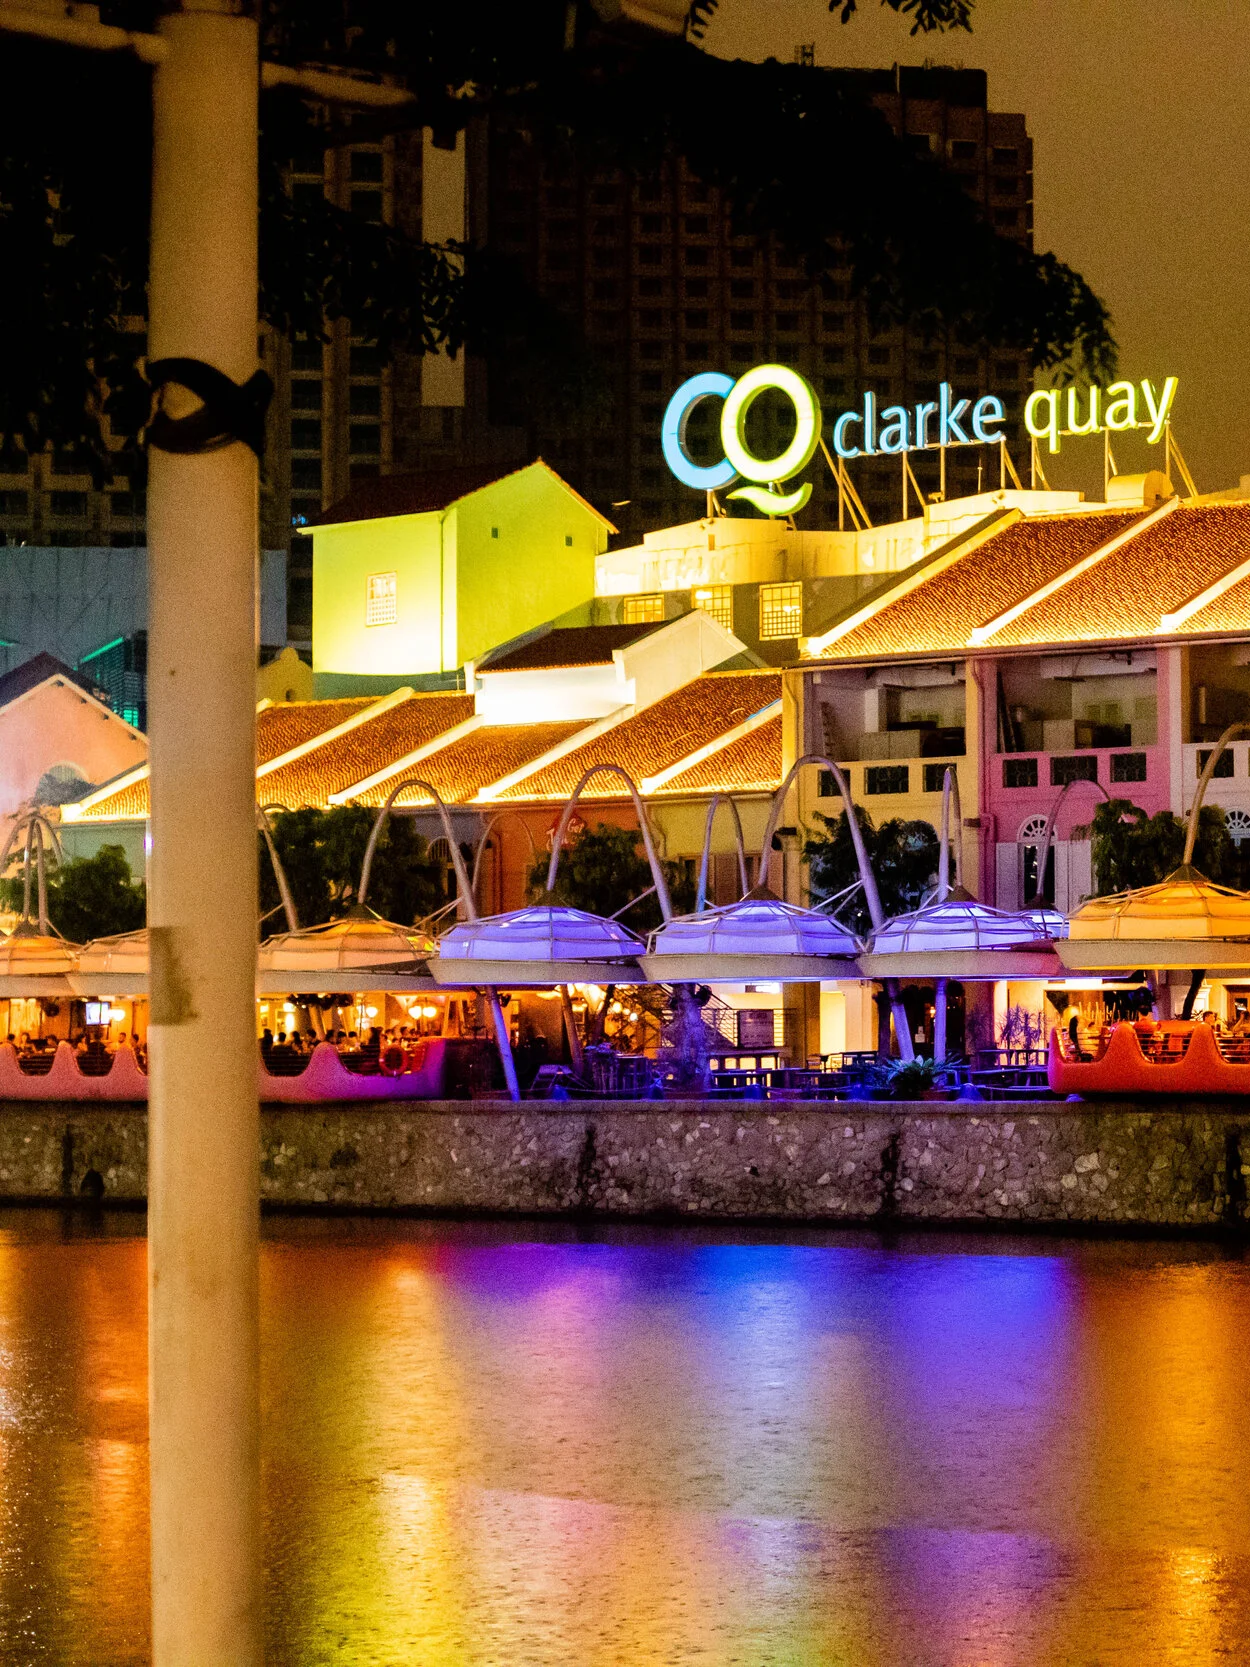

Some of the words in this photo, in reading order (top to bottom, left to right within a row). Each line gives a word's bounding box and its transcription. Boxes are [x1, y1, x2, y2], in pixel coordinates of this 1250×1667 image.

[661, 363, 821, 516] CQ
[833, 382, 1005, 459] clarke
[1023, 376, 1179, 455] quay
